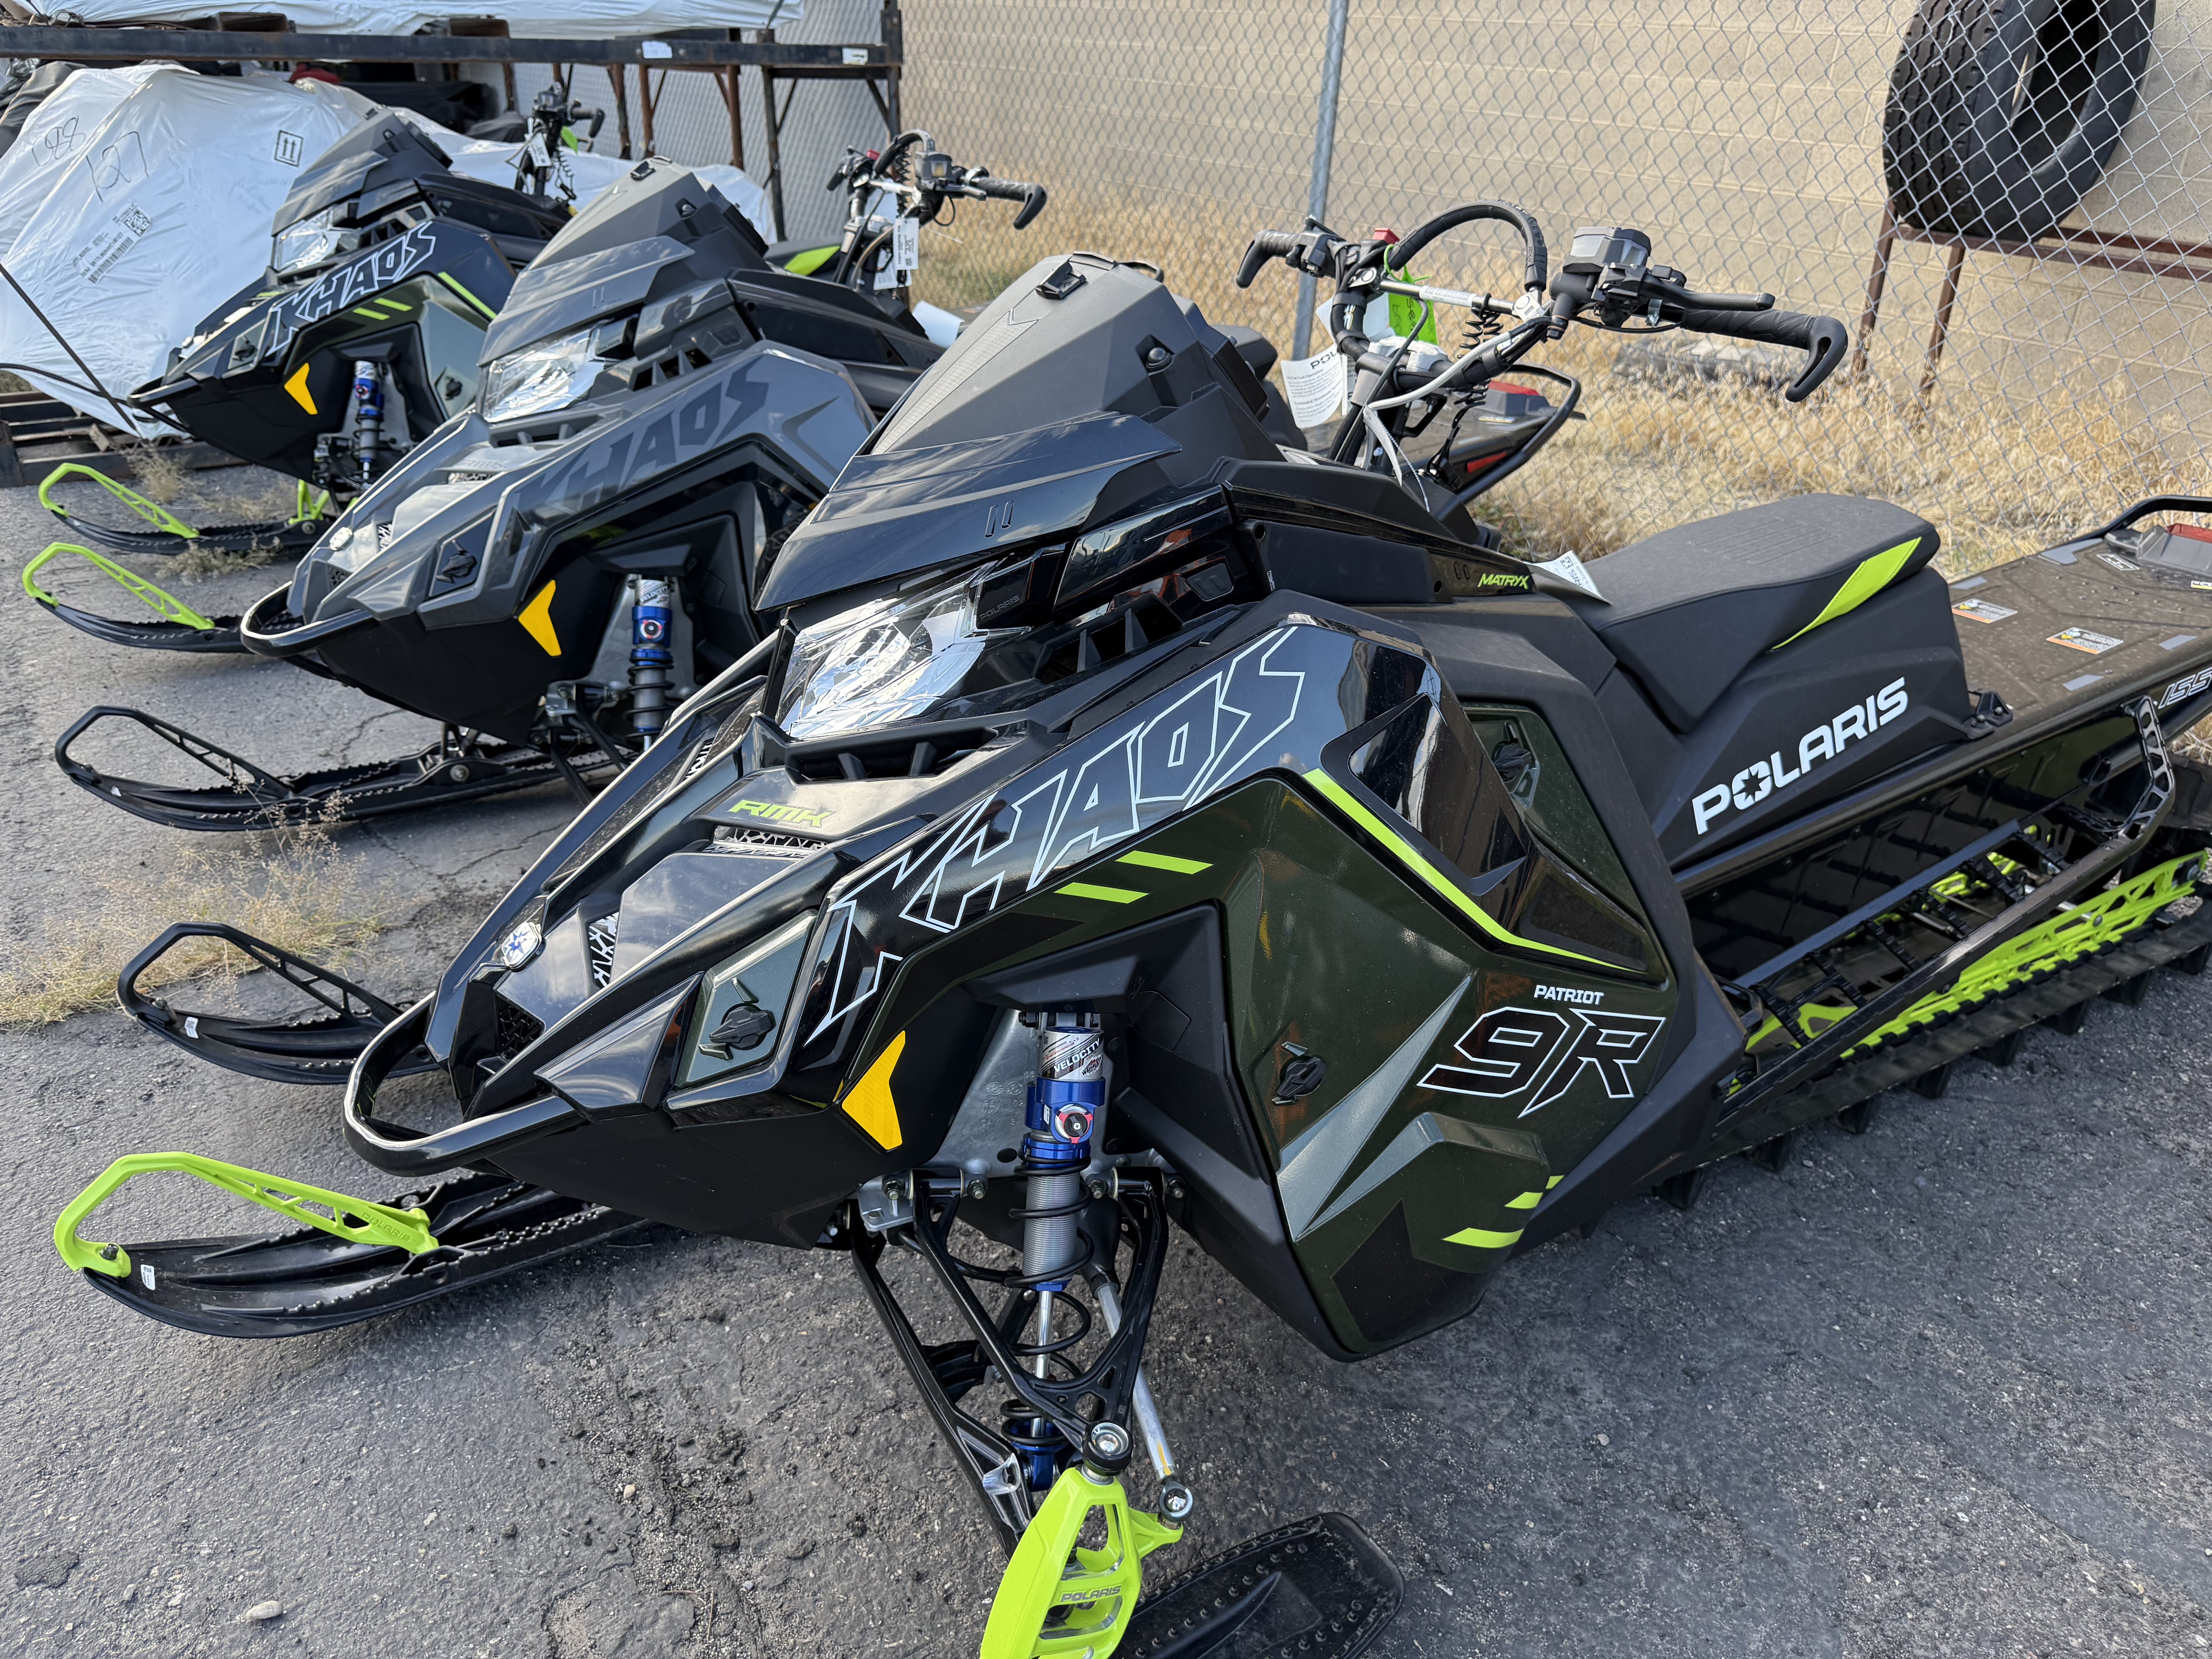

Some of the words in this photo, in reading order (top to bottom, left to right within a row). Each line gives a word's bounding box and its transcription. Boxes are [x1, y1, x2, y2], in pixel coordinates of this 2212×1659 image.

[86, 131, 149, 203] 127
[265, 221, 436, 357] KHAOS
[1310, 350, 1337, 369] POL
[500, 356, 771, 550] KHAOS
[1477, 573, 1530, 589] MATRYX
[979, 595, 1020, 620] POLARIS
[1692, 677, 1908, 835] POLARIS
[728, 799, 836, 828] RMK
[804, 626, 1305, 1047] KHAOS
[1534, 985, 1604, 1005] PATRIOT
[1054, 1038, 1099, 1072] VELOCITY
[1417, 1007, 1666, 1118] 9R
[361, 1212, 412, 1242] POLARIS
[1060, 1585, 1122, 1602] POLARIS
